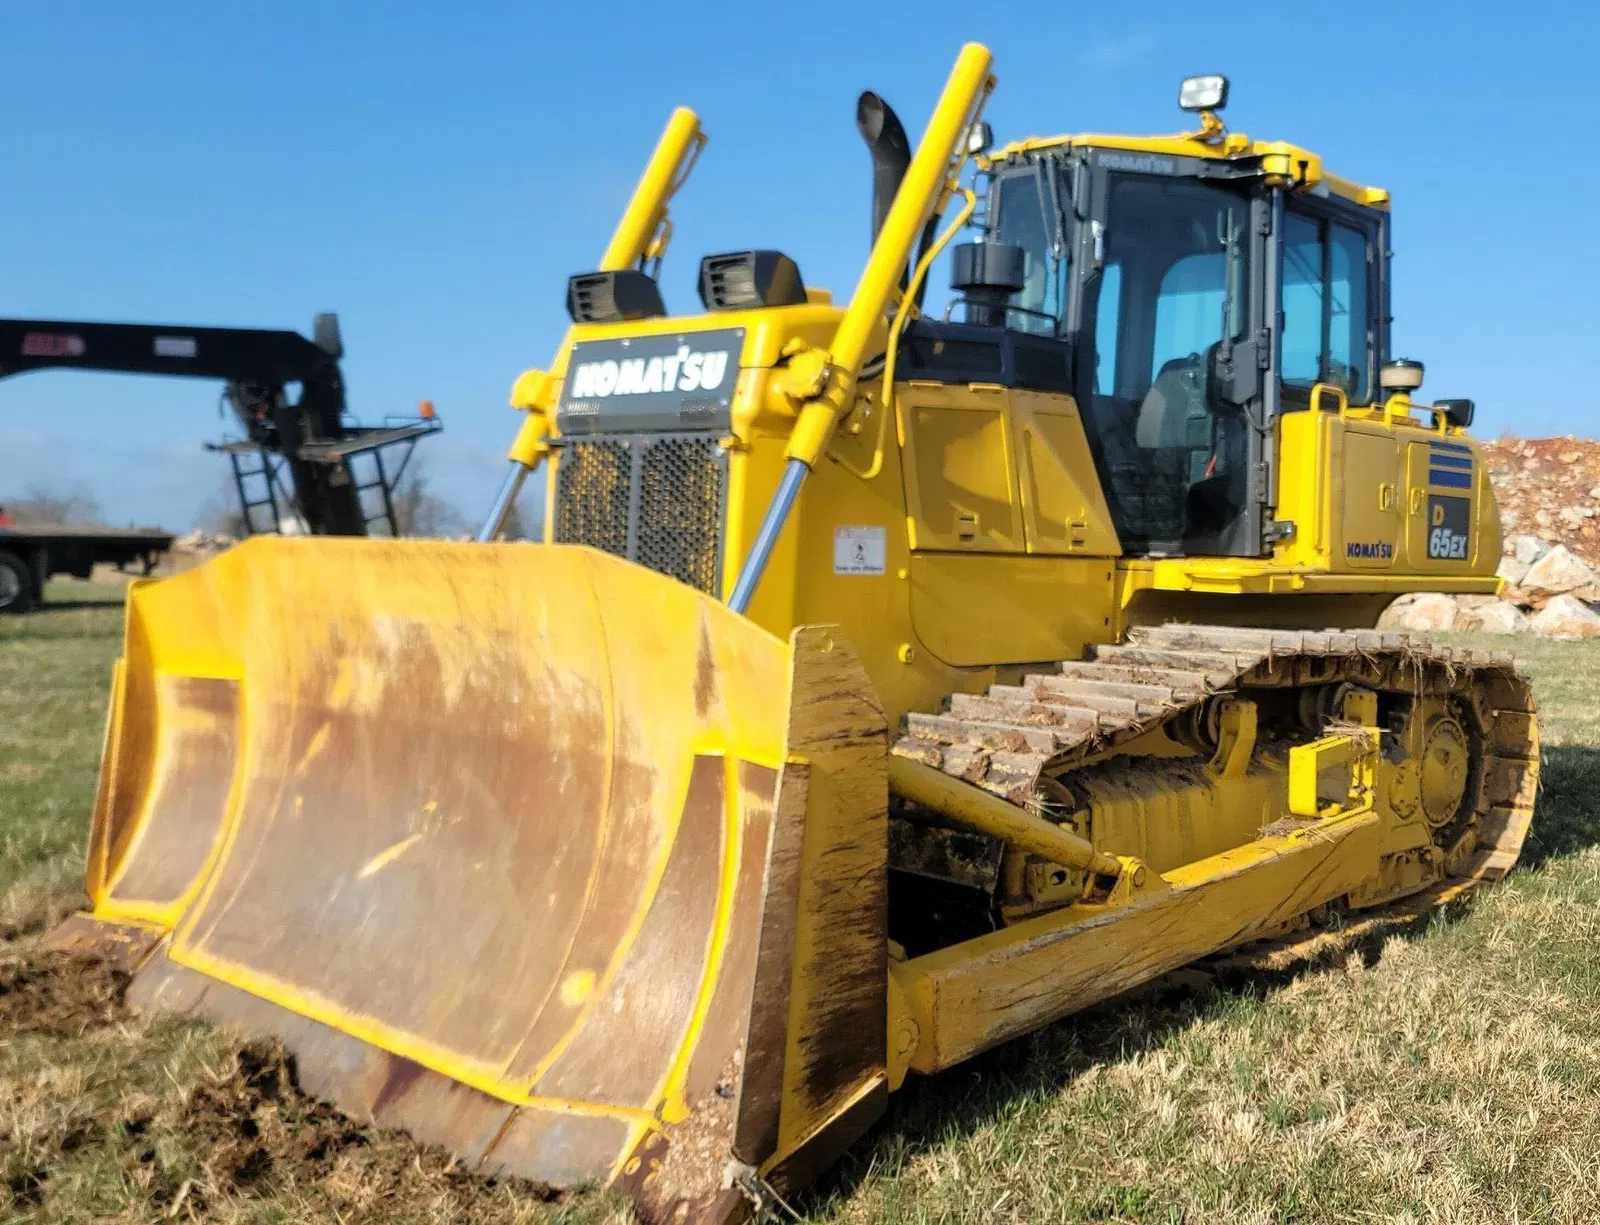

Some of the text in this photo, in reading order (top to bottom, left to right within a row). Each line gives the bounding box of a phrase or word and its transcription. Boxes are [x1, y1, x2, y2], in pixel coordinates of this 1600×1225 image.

[1098, 154, 1174, 173] KOMATSU
[572, 345, 728, 398] KOMATSU
[1433, 504, 1444, 526] D
[1347, 540, 1392, 557] KOMATSU
